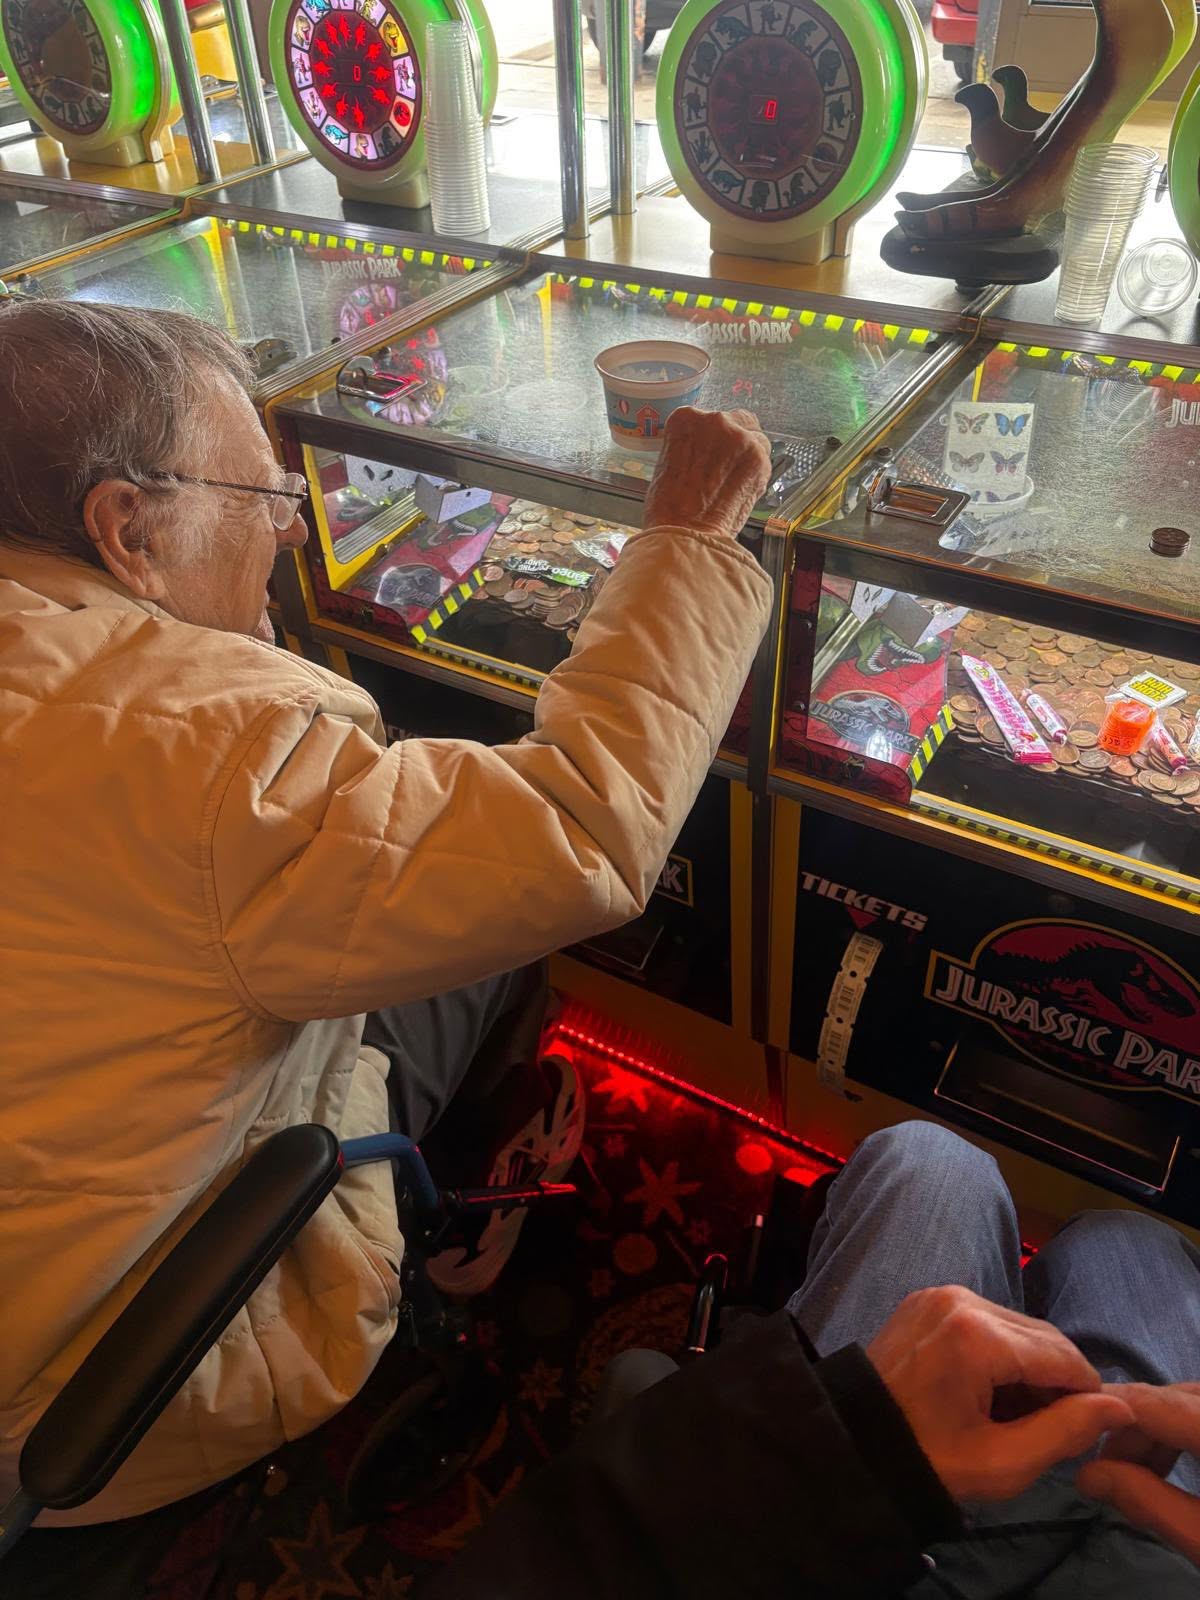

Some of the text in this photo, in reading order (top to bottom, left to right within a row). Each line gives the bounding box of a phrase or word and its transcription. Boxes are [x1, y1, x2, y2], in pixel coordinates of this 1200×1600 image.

[766, 100, 777, 119] 0
[749, 319, 793, 346] PARK
[810, 703, 874, 731] JURASSIC
[801, 871, 928, 932] TICKETS
[936, 965, 1112, 1056] JURASSIC
